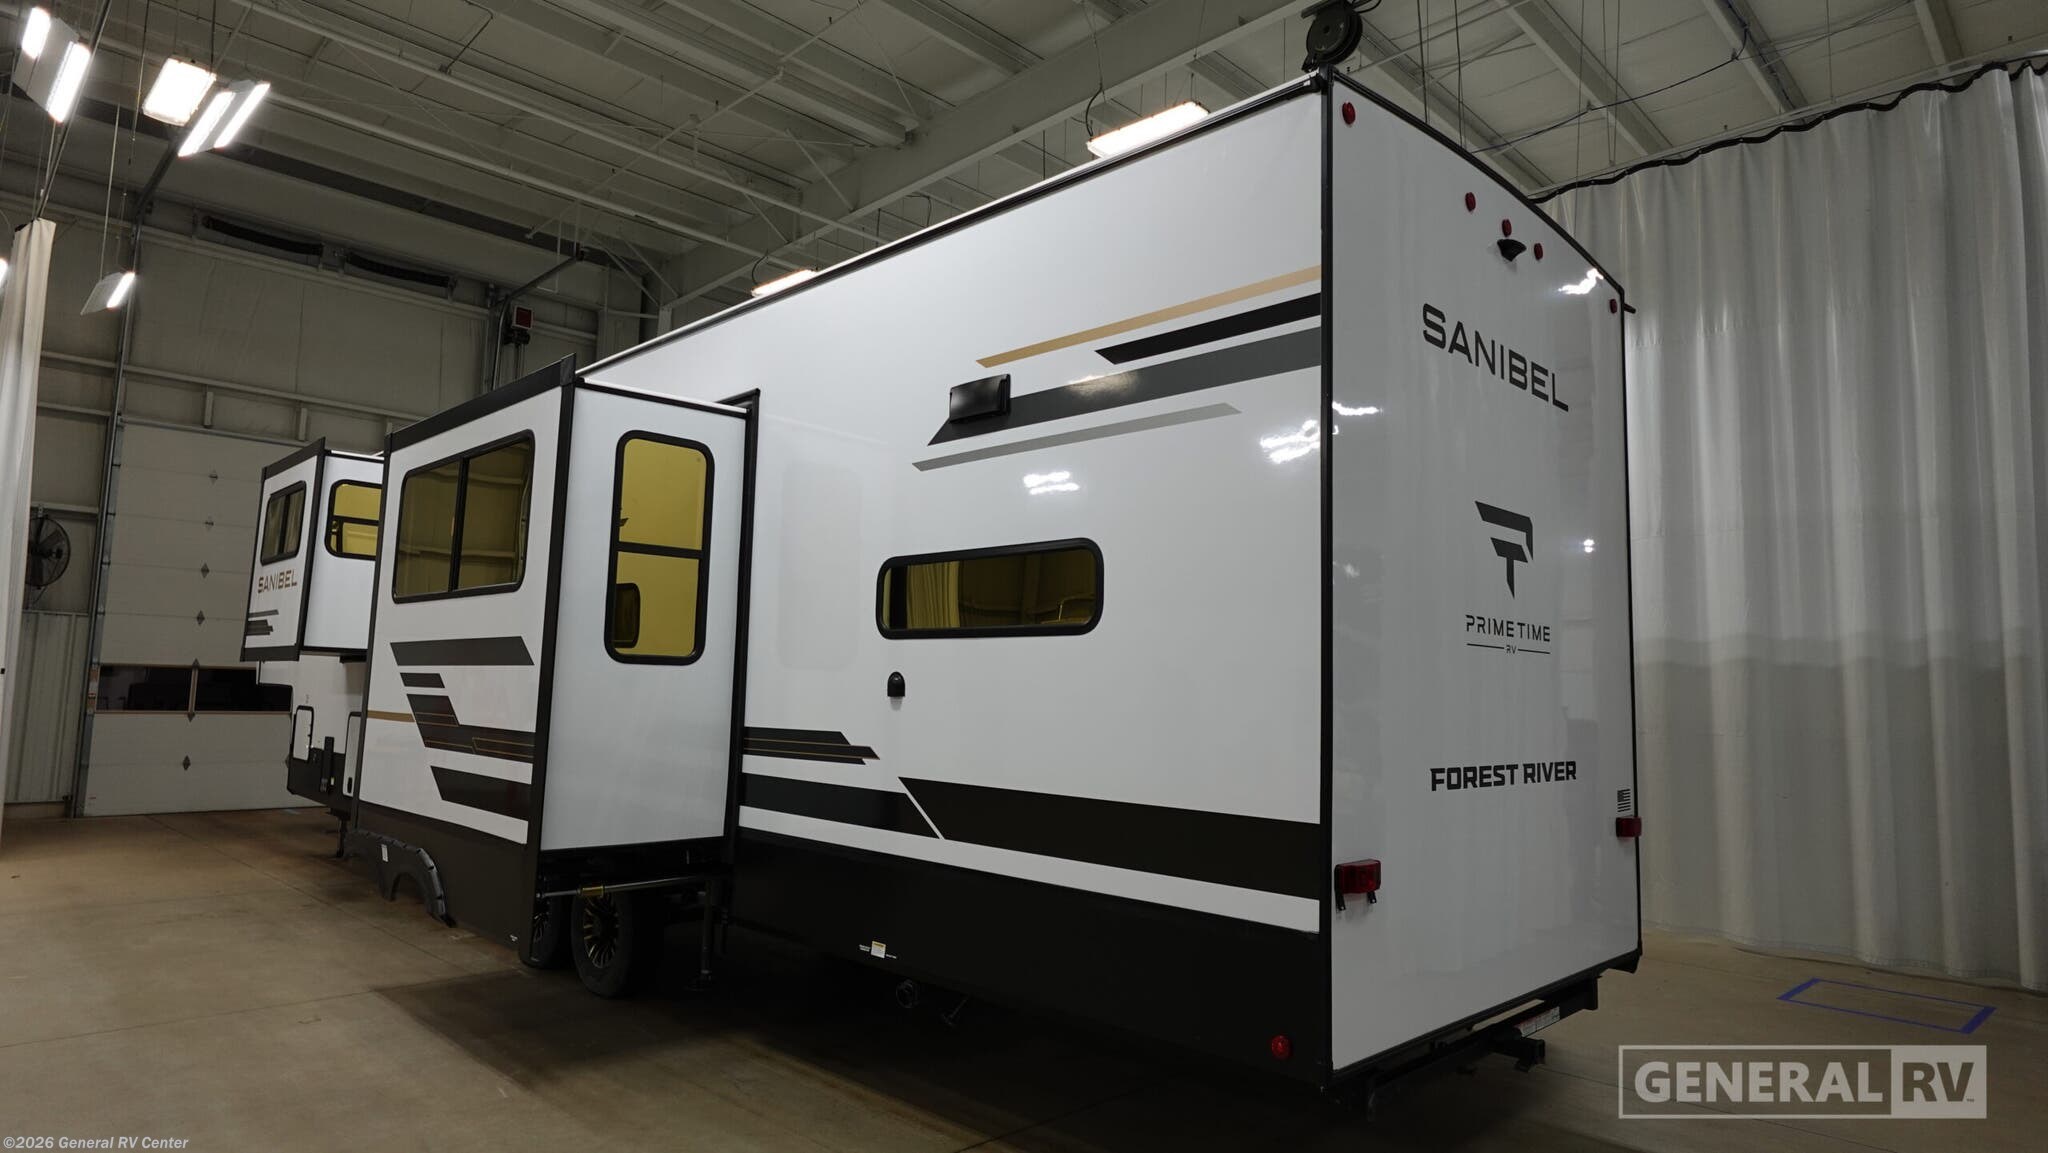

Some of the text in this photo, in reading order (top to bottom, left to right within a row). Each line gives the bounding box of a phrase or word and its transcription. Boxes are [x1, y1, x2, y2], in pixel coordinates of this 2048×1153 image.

[1423, 303, 1569, 412] SANIBEL
[258, 570, 297, 593] SANIBEL
[1506, 644, 1517, 655] RV
[1430, 761, 1577, 792] FOREST RIVER
